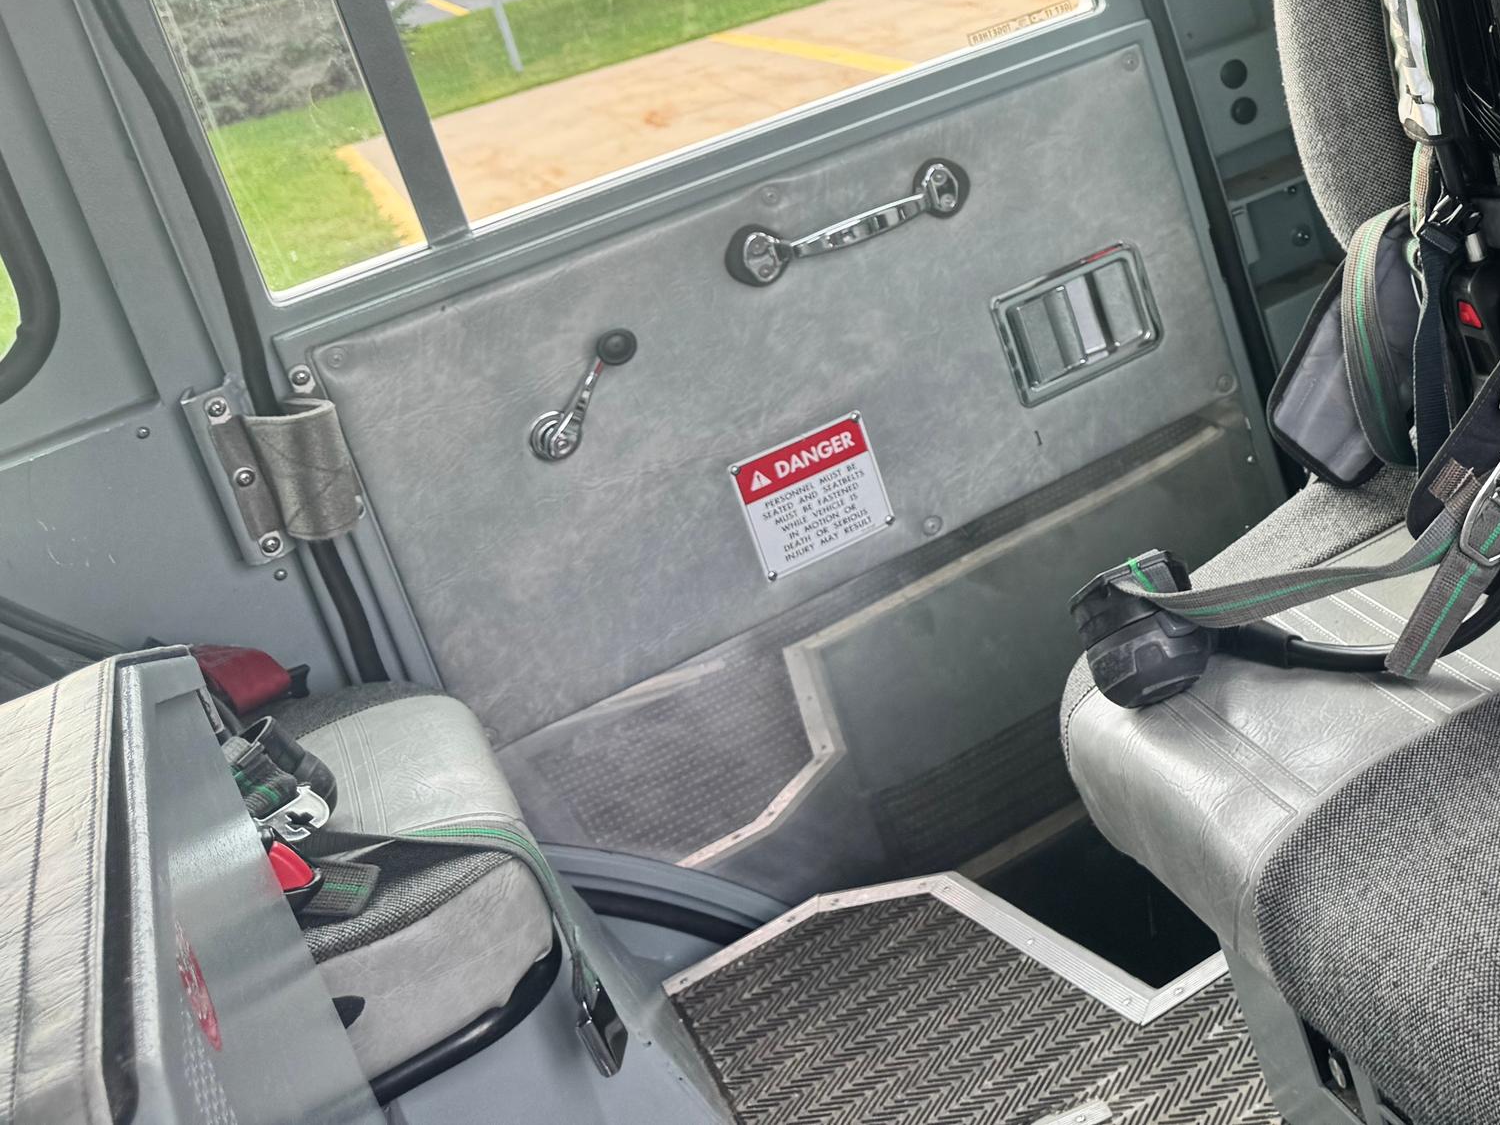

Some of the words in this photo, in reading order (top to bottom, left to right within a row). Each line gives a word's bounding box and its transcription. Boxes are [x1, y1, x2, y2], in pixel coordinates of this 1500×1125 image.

[774, 431, 855, 479] DANGER
[820, 469, 842, 484] MUST
[846, 463, 857, 473] BE
[763, 502, 794, 520] SEATED
[800, 491, 818, 504] AND
[775, 510, 798, 525] MUST
[803, 504, 813, 514] BE
[782, 517, 806, 533] WHILE
[813, 499, 845, 518] VEHICLE
[789, 530, 799, 539] IN
[804, 513, 840, 533] MOTION
[784, 535, 811, 552] DEATH
[820, 533, 839, 546] MAY
